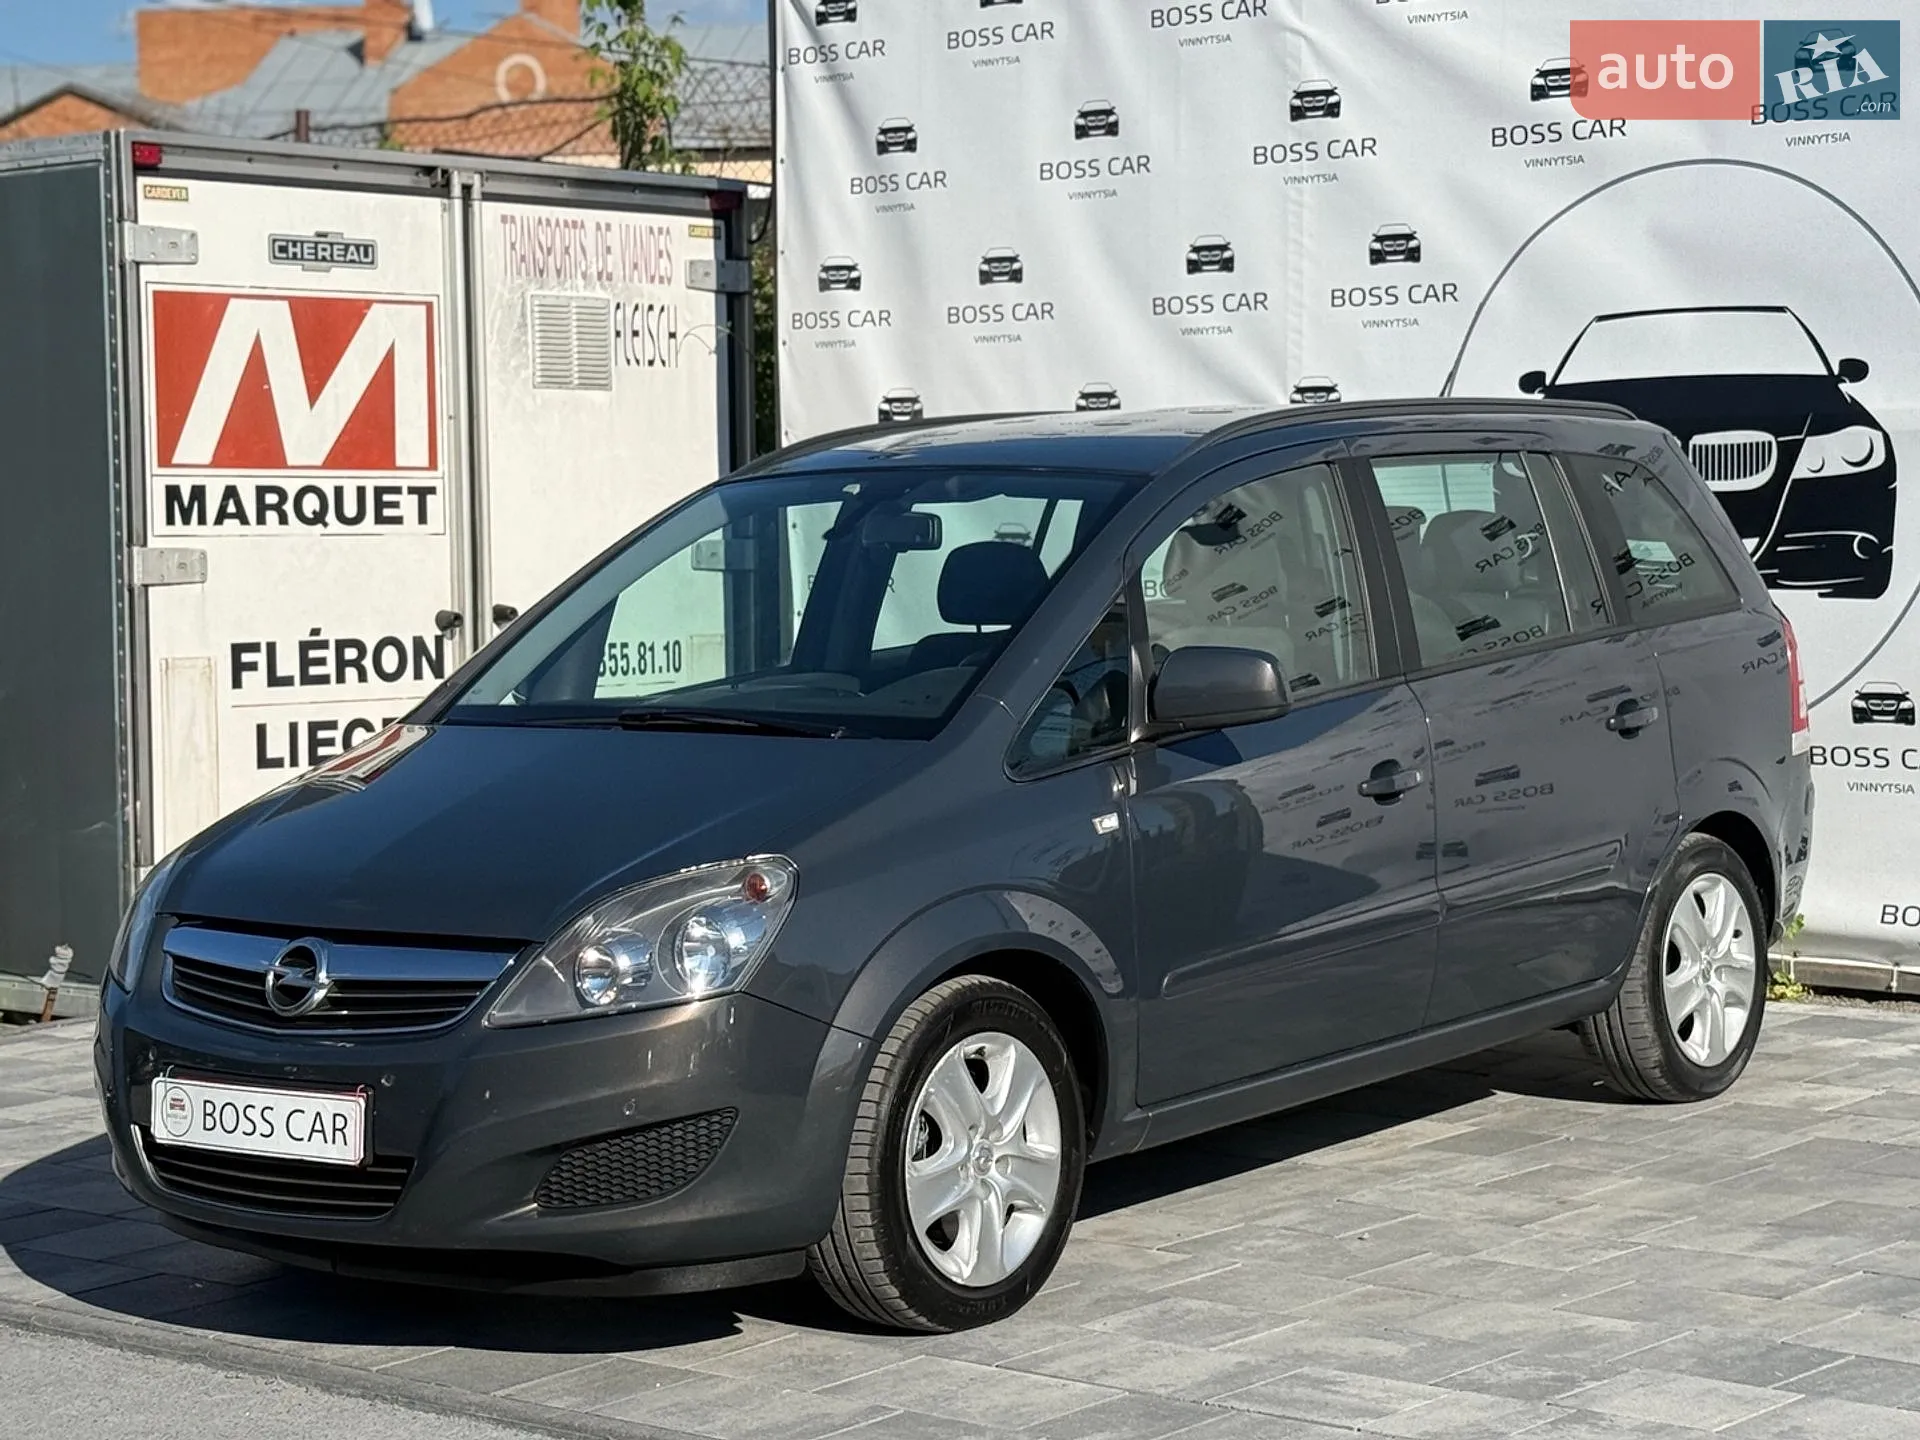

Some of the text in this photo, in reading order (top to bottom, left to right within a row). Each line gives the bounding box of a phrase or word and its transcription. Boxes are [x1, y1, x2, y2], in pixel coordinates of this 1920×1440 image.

[1151, 0, 1267, 28] BOSS CAR
[1407, 11, 1468, 24] VINNYTSIA
[948, 22, 1054, 49] BOSS CAR
[787, 39, 885, 66] BOSS CAR
[1492, 116, 1626, 147] BOSS CAR
[1786, 132, 1850, 147] VINNYTSIA
[1254, 138, 1376, 165] BOSS CAR
[1524, 155, 1584, 168] VINNYTSIA
[1040, 155, 1150, 180] BOSS CAR
[1283, 173, 1339, 185] VINNYTSIA
[851, 171, 947, 194] BOSS CAR
[273, 240, 374, 263] CHEREAU
[500, 214, 673, 287] TRANSPORTS DE VIANDES
[1152, 292, 1268, 315] BOSS CAR
[1331, 283, 1458, 307] BOSS CAR
[792, 310, 891, 329] BOSS CAR
[948, 302, 1054, 324] BOSS CAR
[1362, 318, 1419, 328] VINNYTSIA
[614, 302, 679, 368] FLEISCH
[1179, 326, 1232, 336] VINNYTSIA
[165, 485, 437, 528] MARQUET
[230, 627, 446, 690] FLÉRON
[1810, 746, 1890, 768] BOSS
[1847, 782, 1915, 794] VINNYTSIA
[202, 1100, 348, 1147] BOSS CAR
